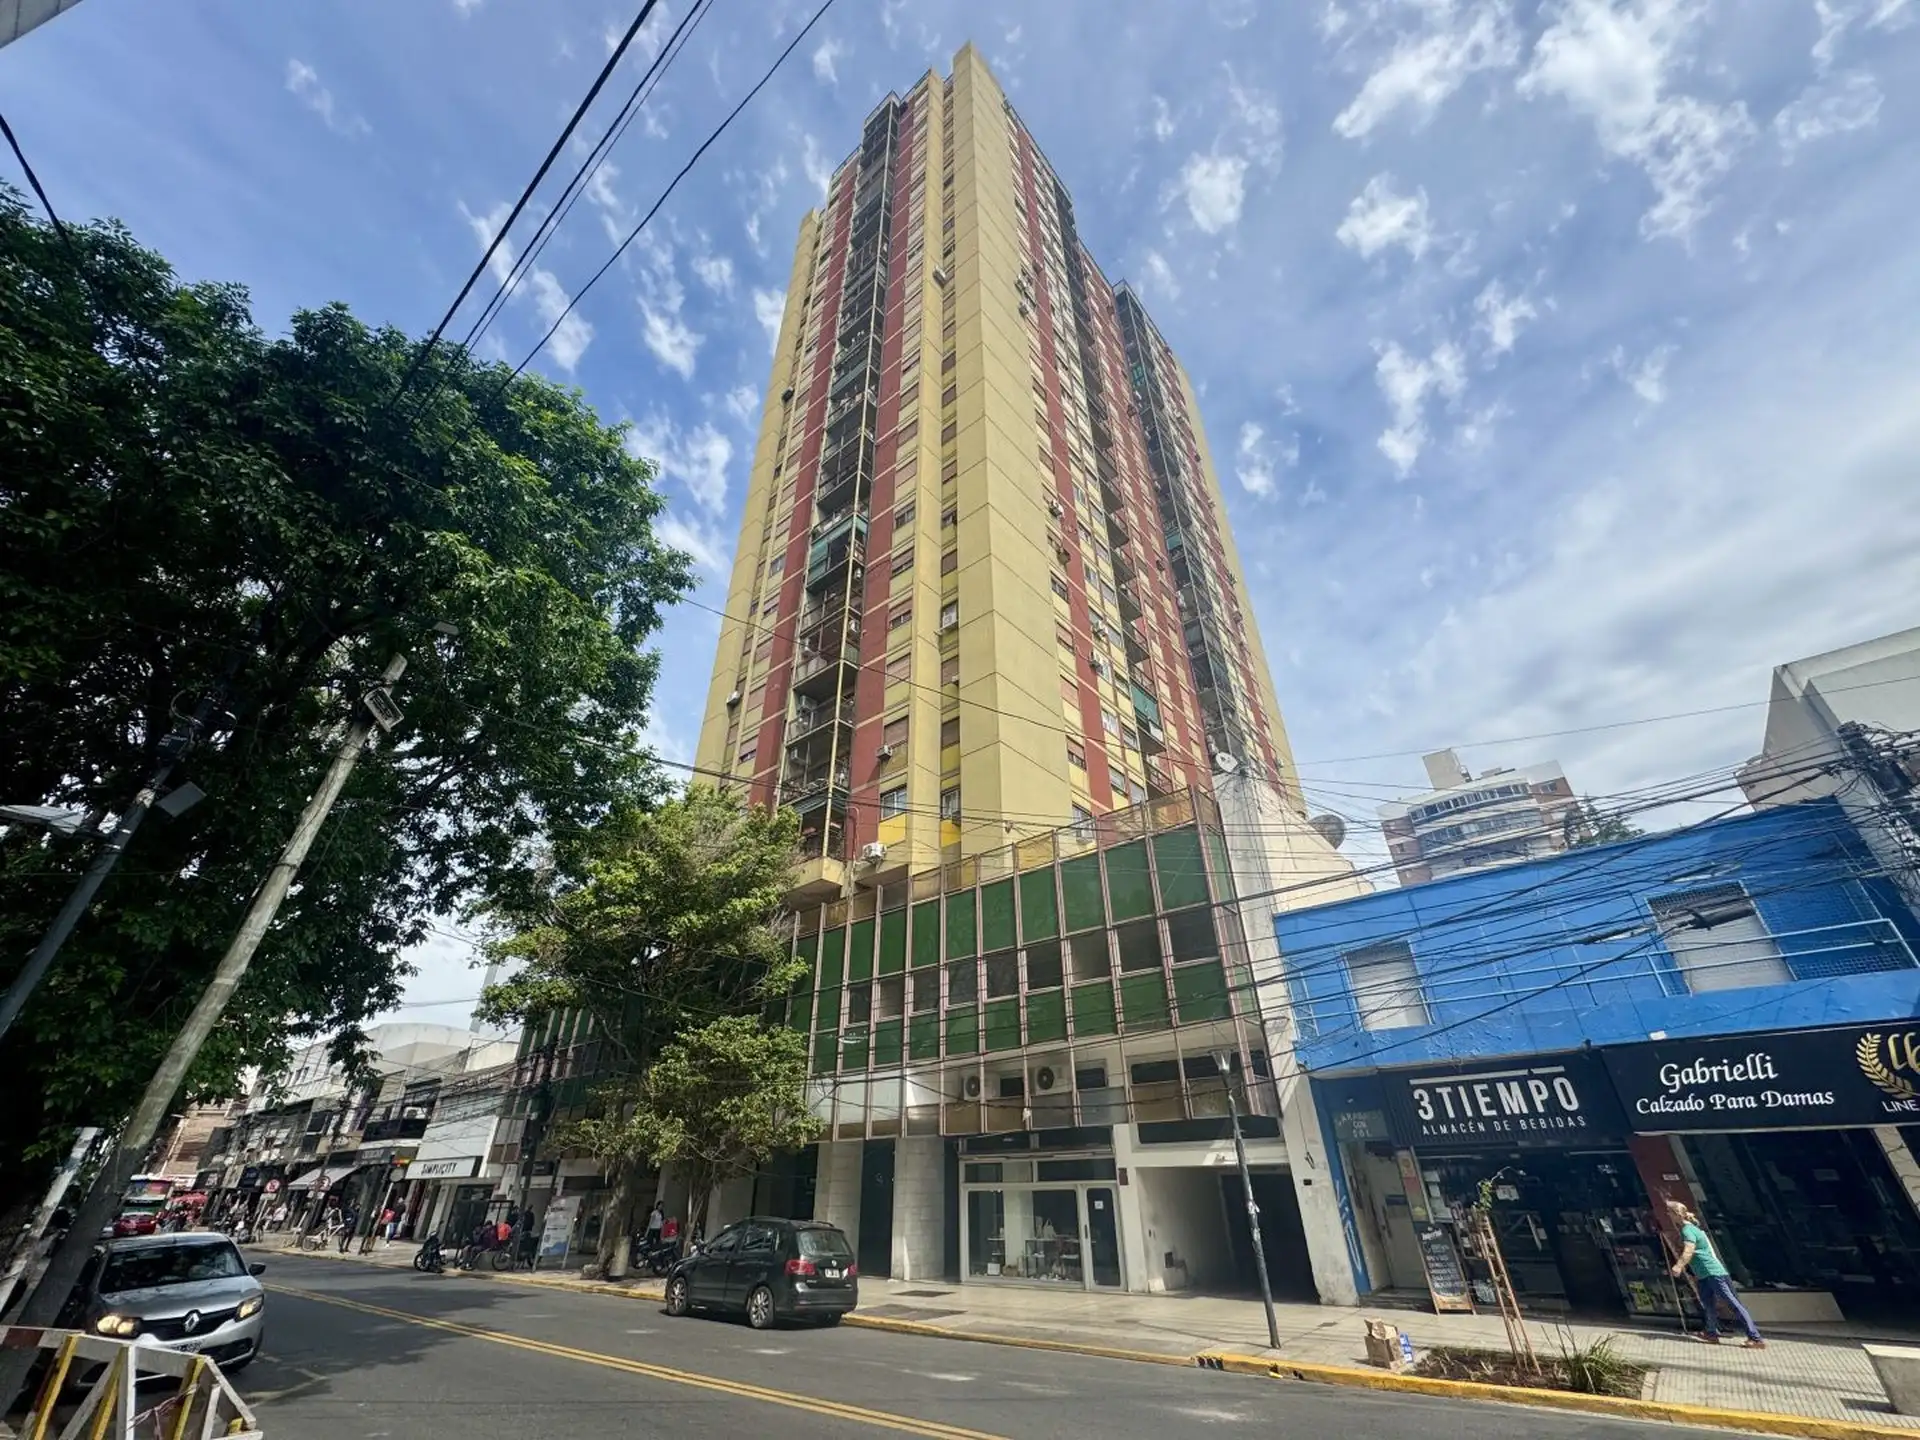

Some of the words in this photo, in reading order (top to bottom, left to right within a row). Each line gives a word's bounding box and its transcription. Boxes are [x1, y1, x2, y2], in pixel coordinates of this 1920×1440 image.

[1660, 1053, 1779, 1093] Gabrielli
[1636, 1093, 1705, 1114] Calzado
[1709, 1093, 1758, 1110] Para
[1760, 1090, 1835, 1108] Damas
[1422, 1120, 1486, 1136] ALMACÉN
[1493, 1119, 1512, 1132] DE
[1519, 1116, 1587, 1131] BEBIDAS
